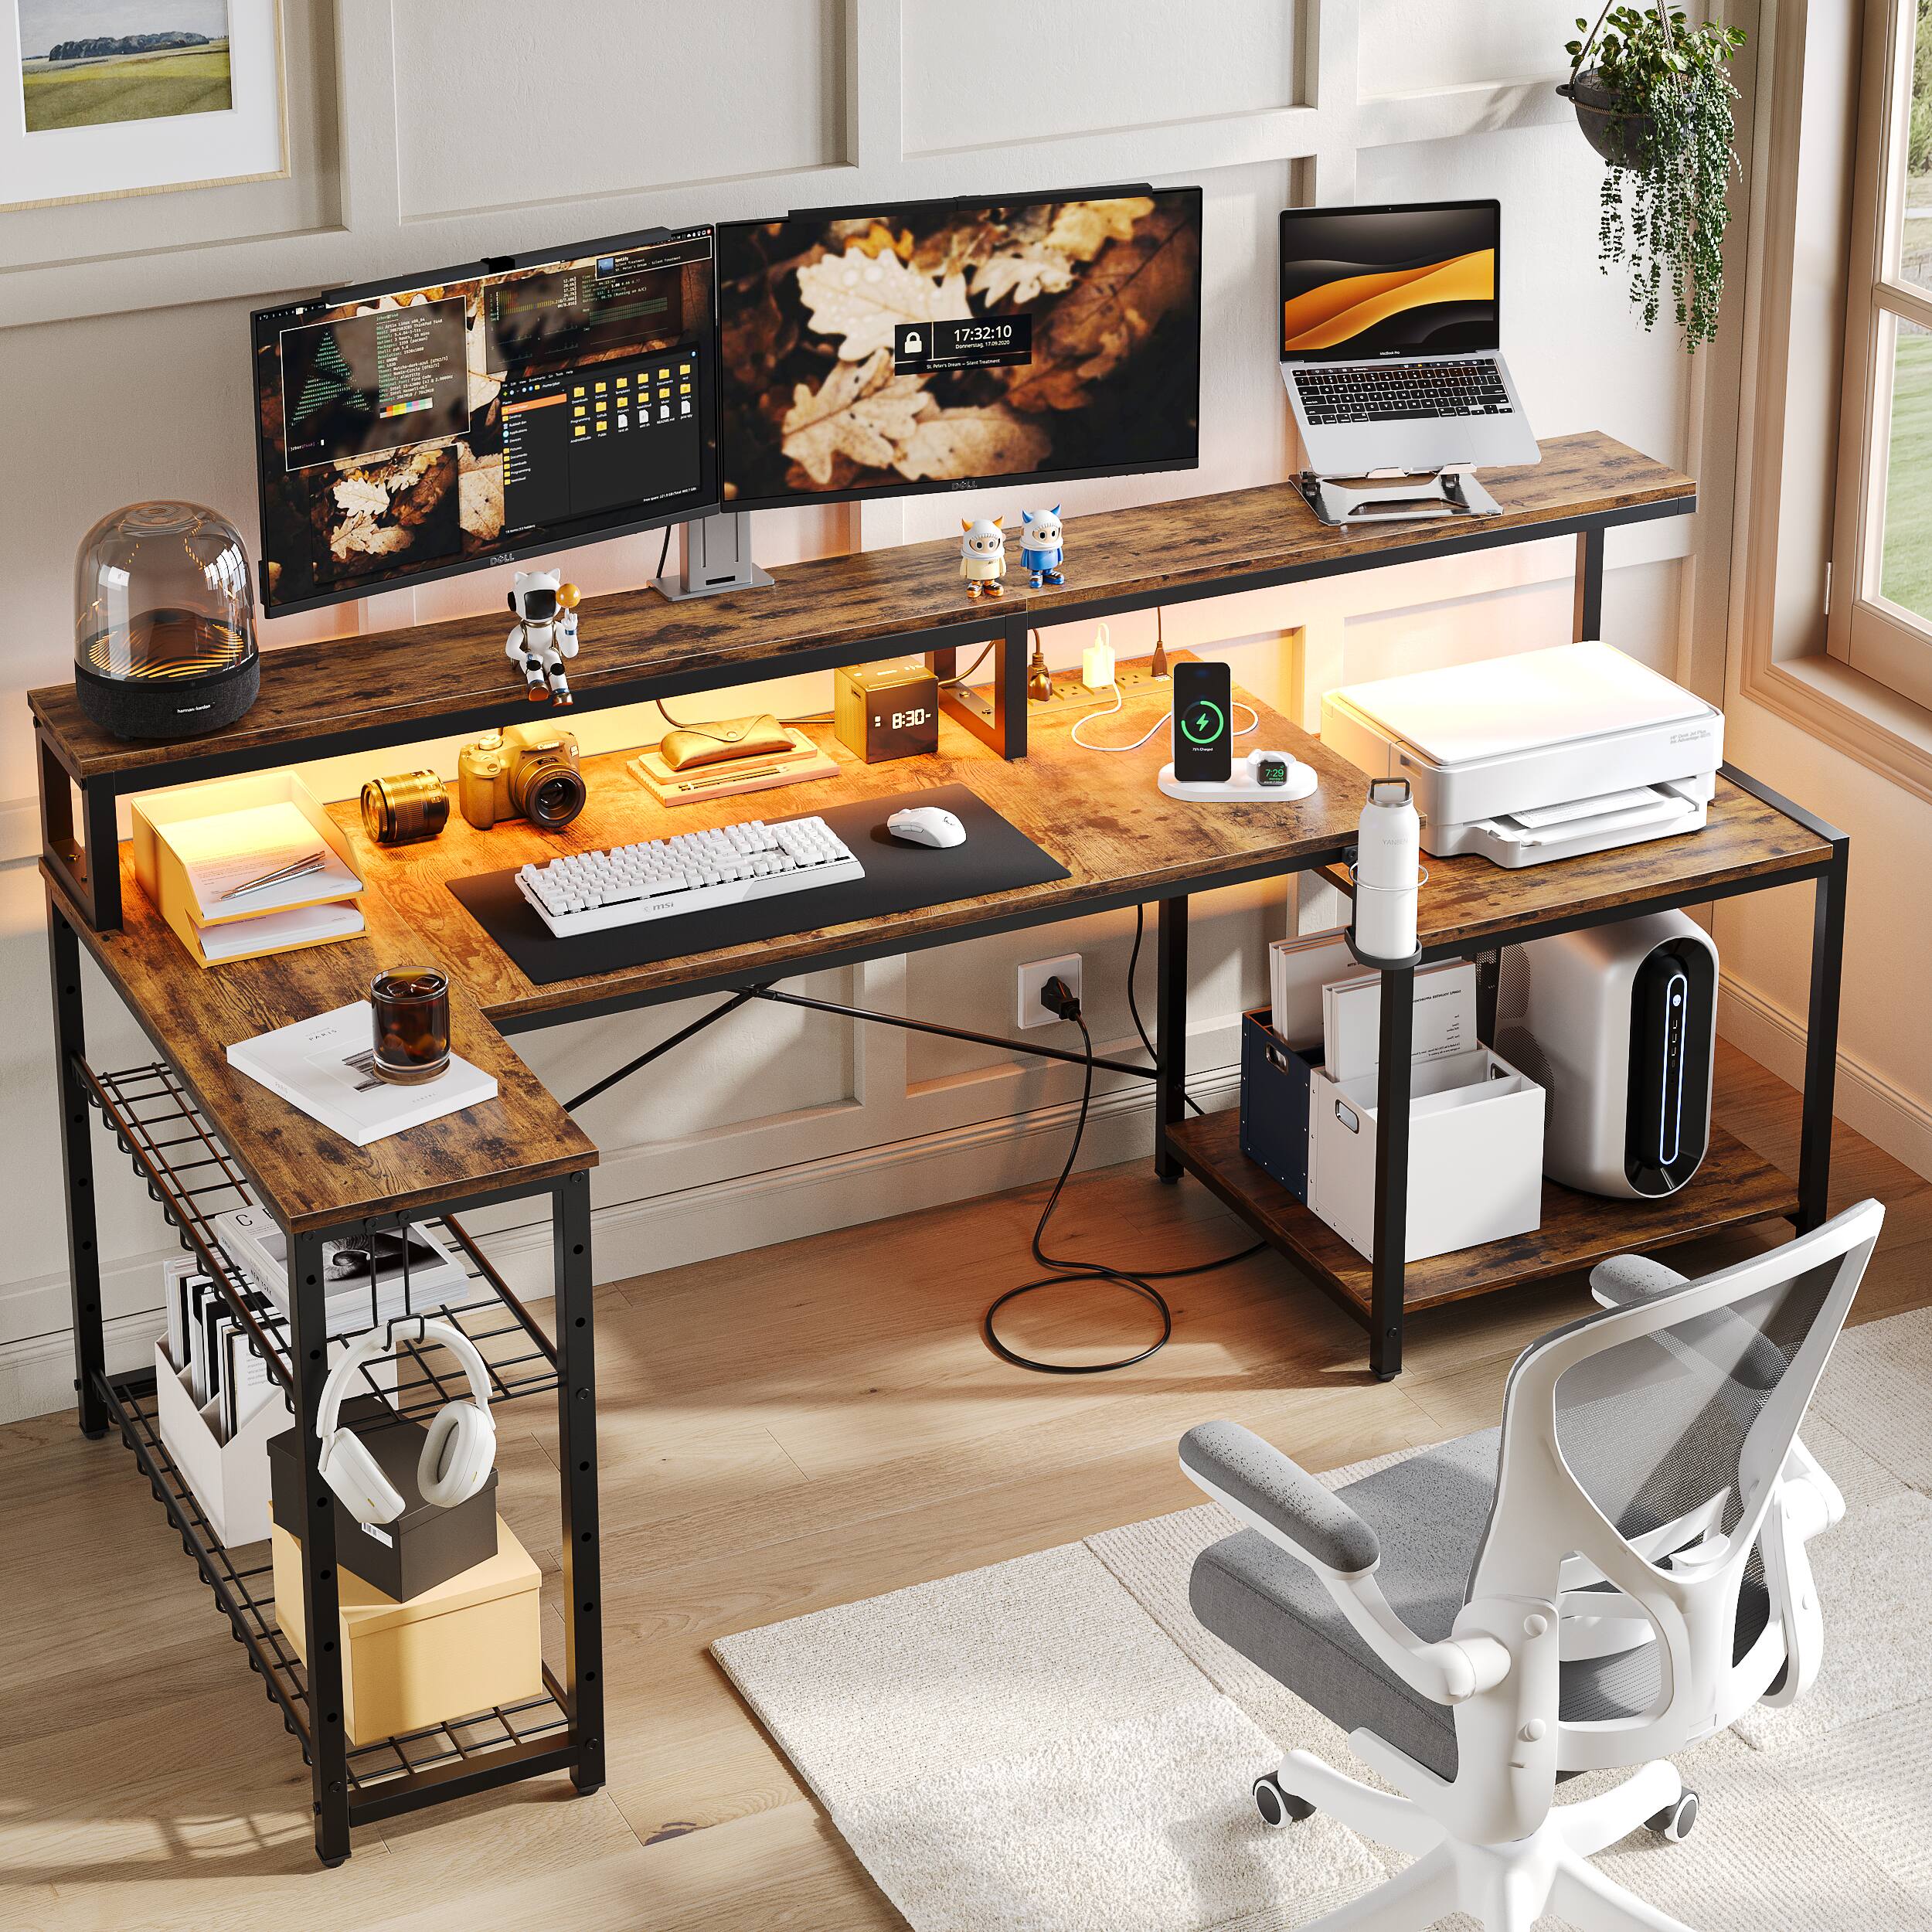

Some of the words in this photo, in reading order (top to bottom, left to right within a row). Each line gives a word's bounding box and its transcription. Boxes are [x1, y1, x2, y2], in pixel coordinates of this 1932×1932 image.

[954, 325, 1012, 342] 17:32:10
[952, 481, 977, 490] DELL
[490, 553, 515, 566] DELL
[537, 741, 560, 750] Canon
[1265, 769, 1284, 777] 7:29
[653, 901, 674, 910] msi
[308, 1029, 337, 1041] PARIS
